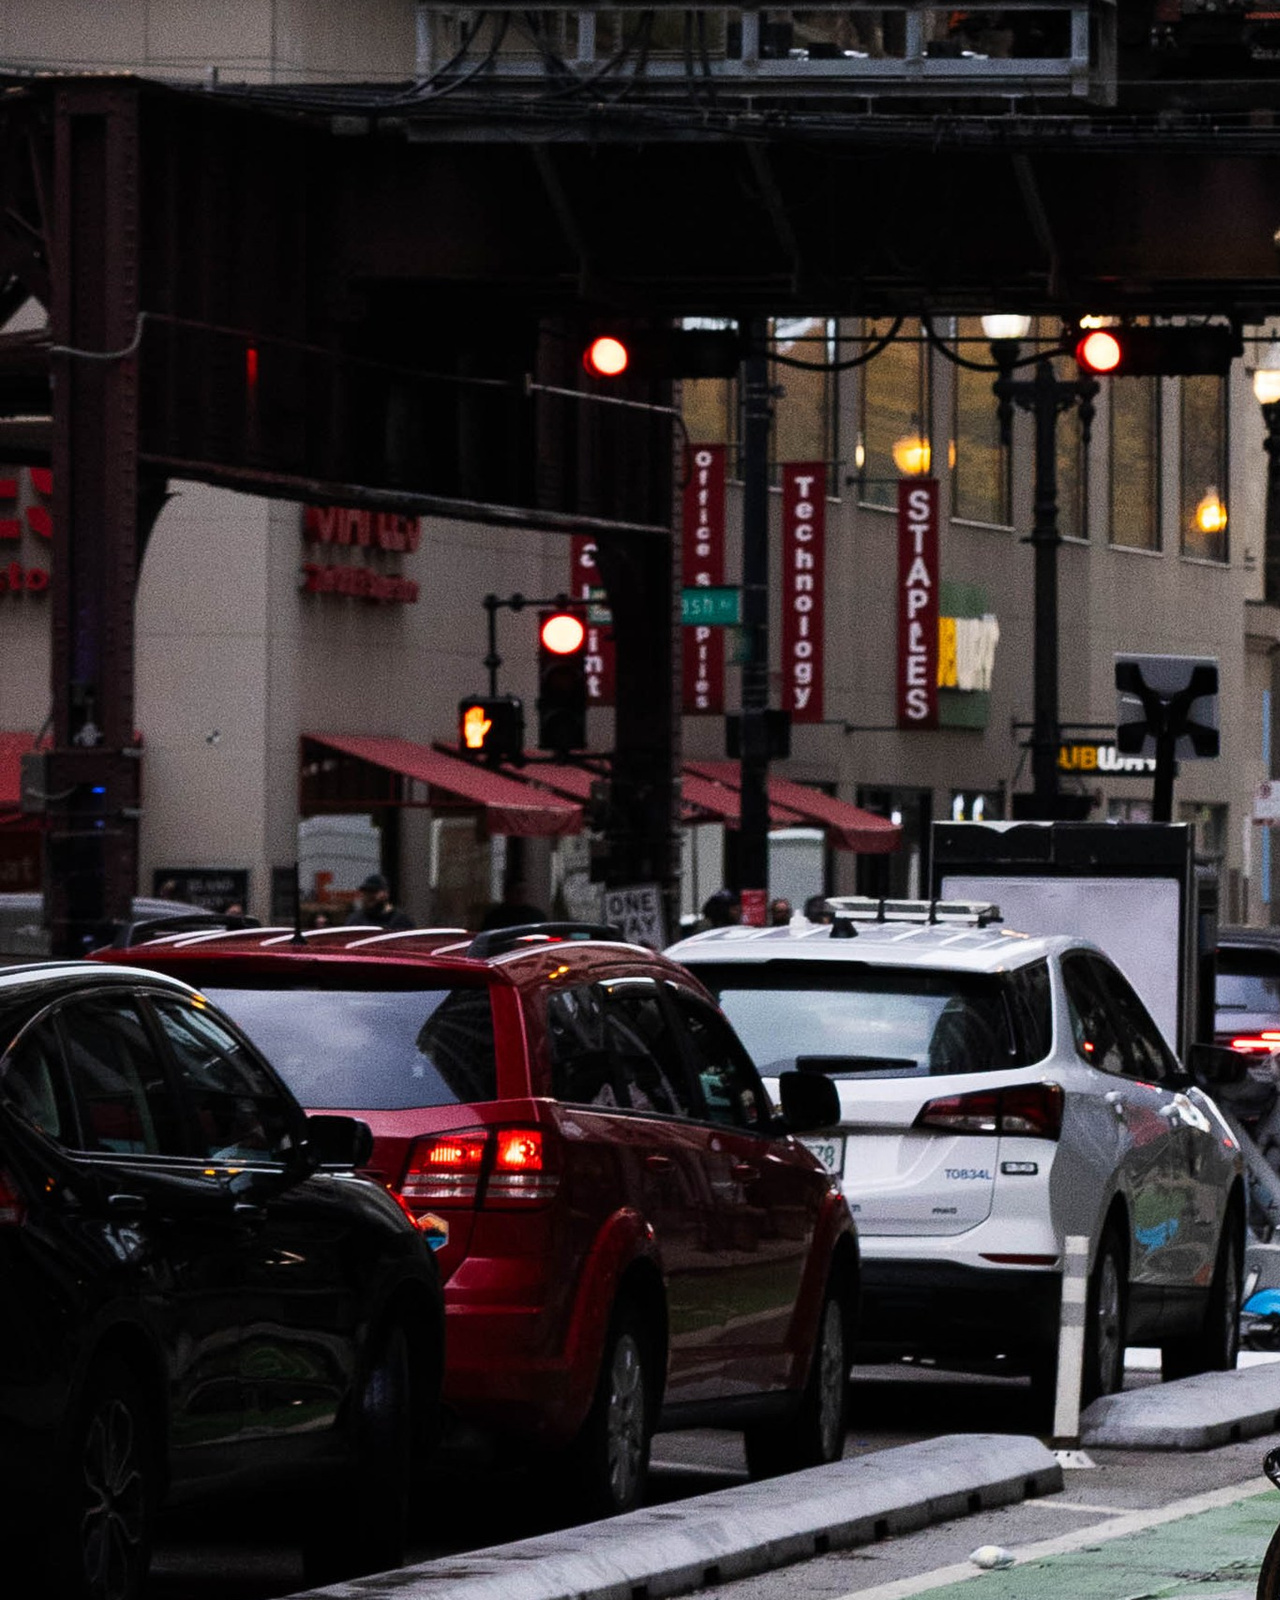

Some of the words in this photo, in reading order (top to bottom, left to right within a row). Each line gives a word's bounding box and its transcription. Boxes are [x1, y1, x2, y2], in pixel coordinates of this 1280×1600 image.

[695, 450, 713, 557] Office
[793, 475, 815, 710] Technology
[905, 489, 932, 720] STAPLES
[608, 891, 655, 916] ONE
